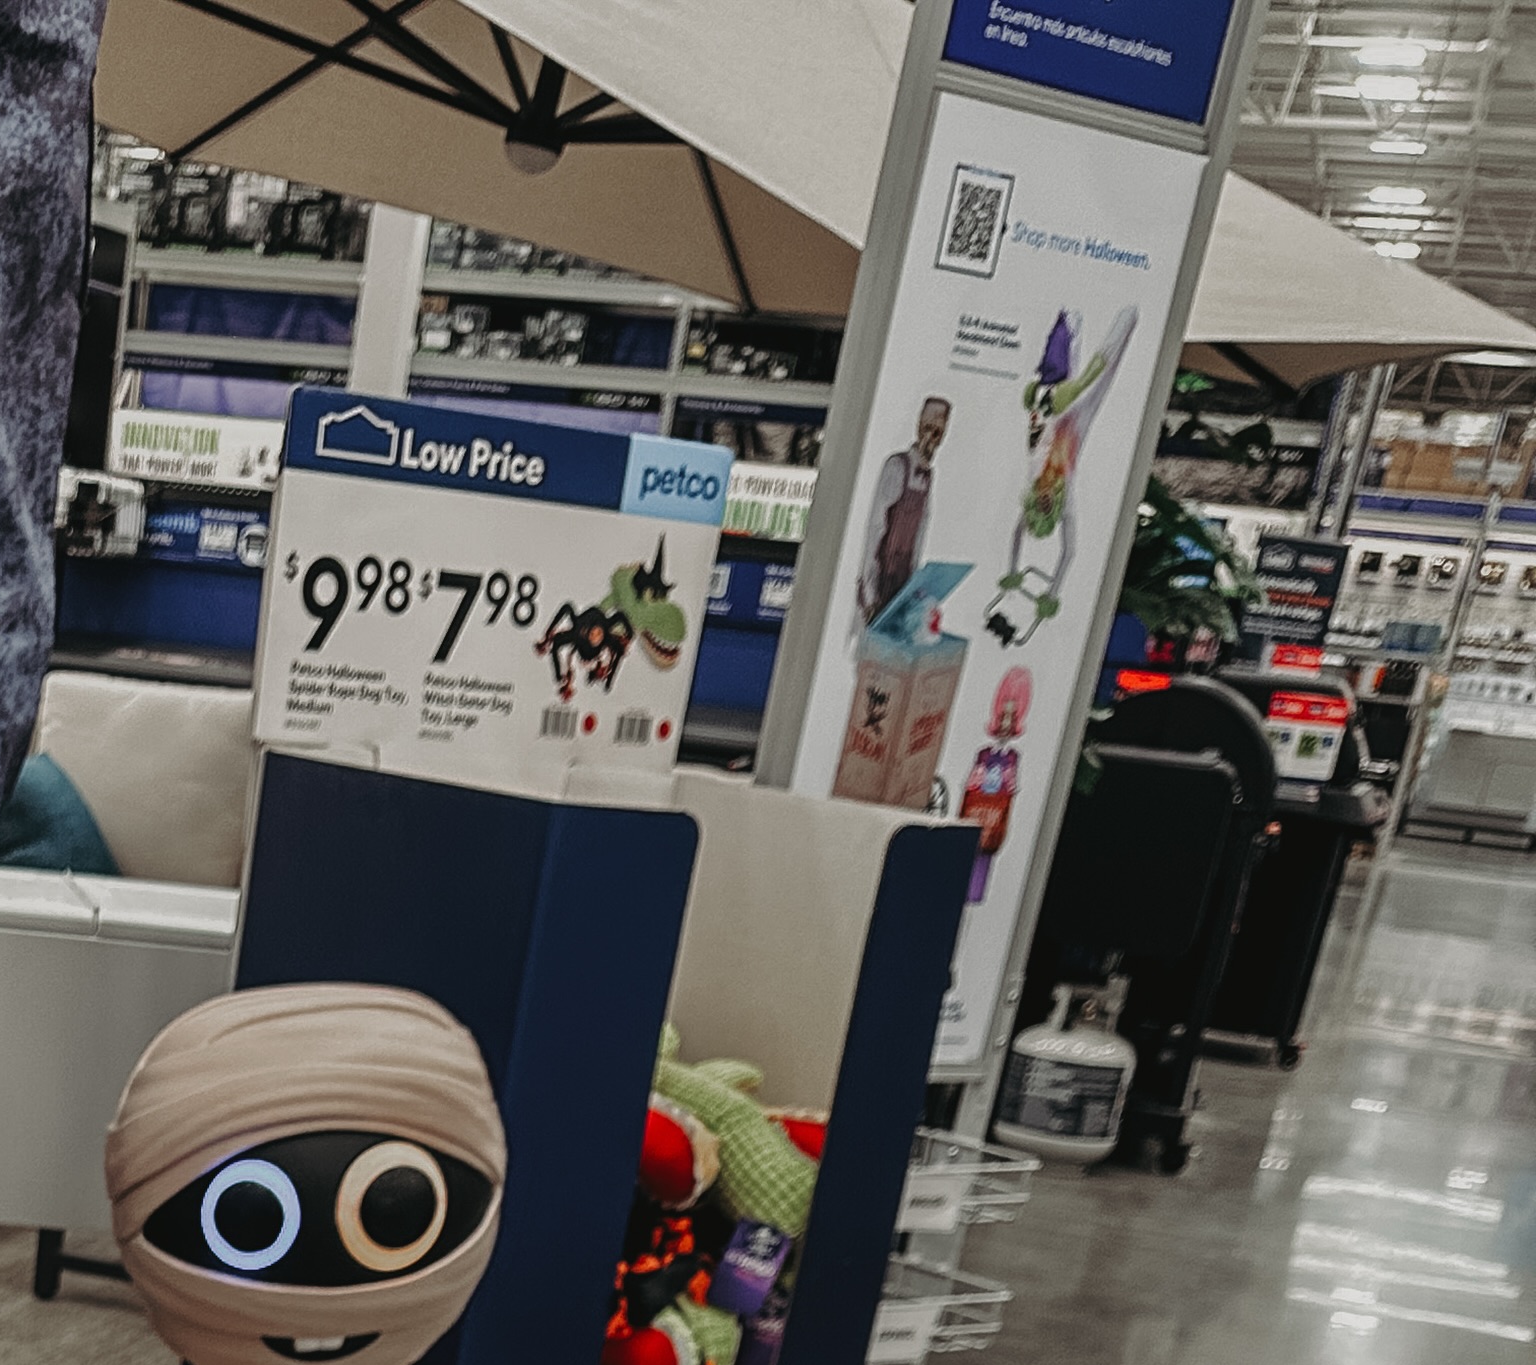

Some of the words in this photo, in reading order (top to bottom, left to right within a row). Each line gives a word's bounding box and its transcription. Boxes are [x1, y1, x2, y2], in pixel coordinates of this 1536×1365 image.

[400, 427, 466, 475] Low
[468, 438, 546, 487] Price
[638, 464, 721, 501] petco
